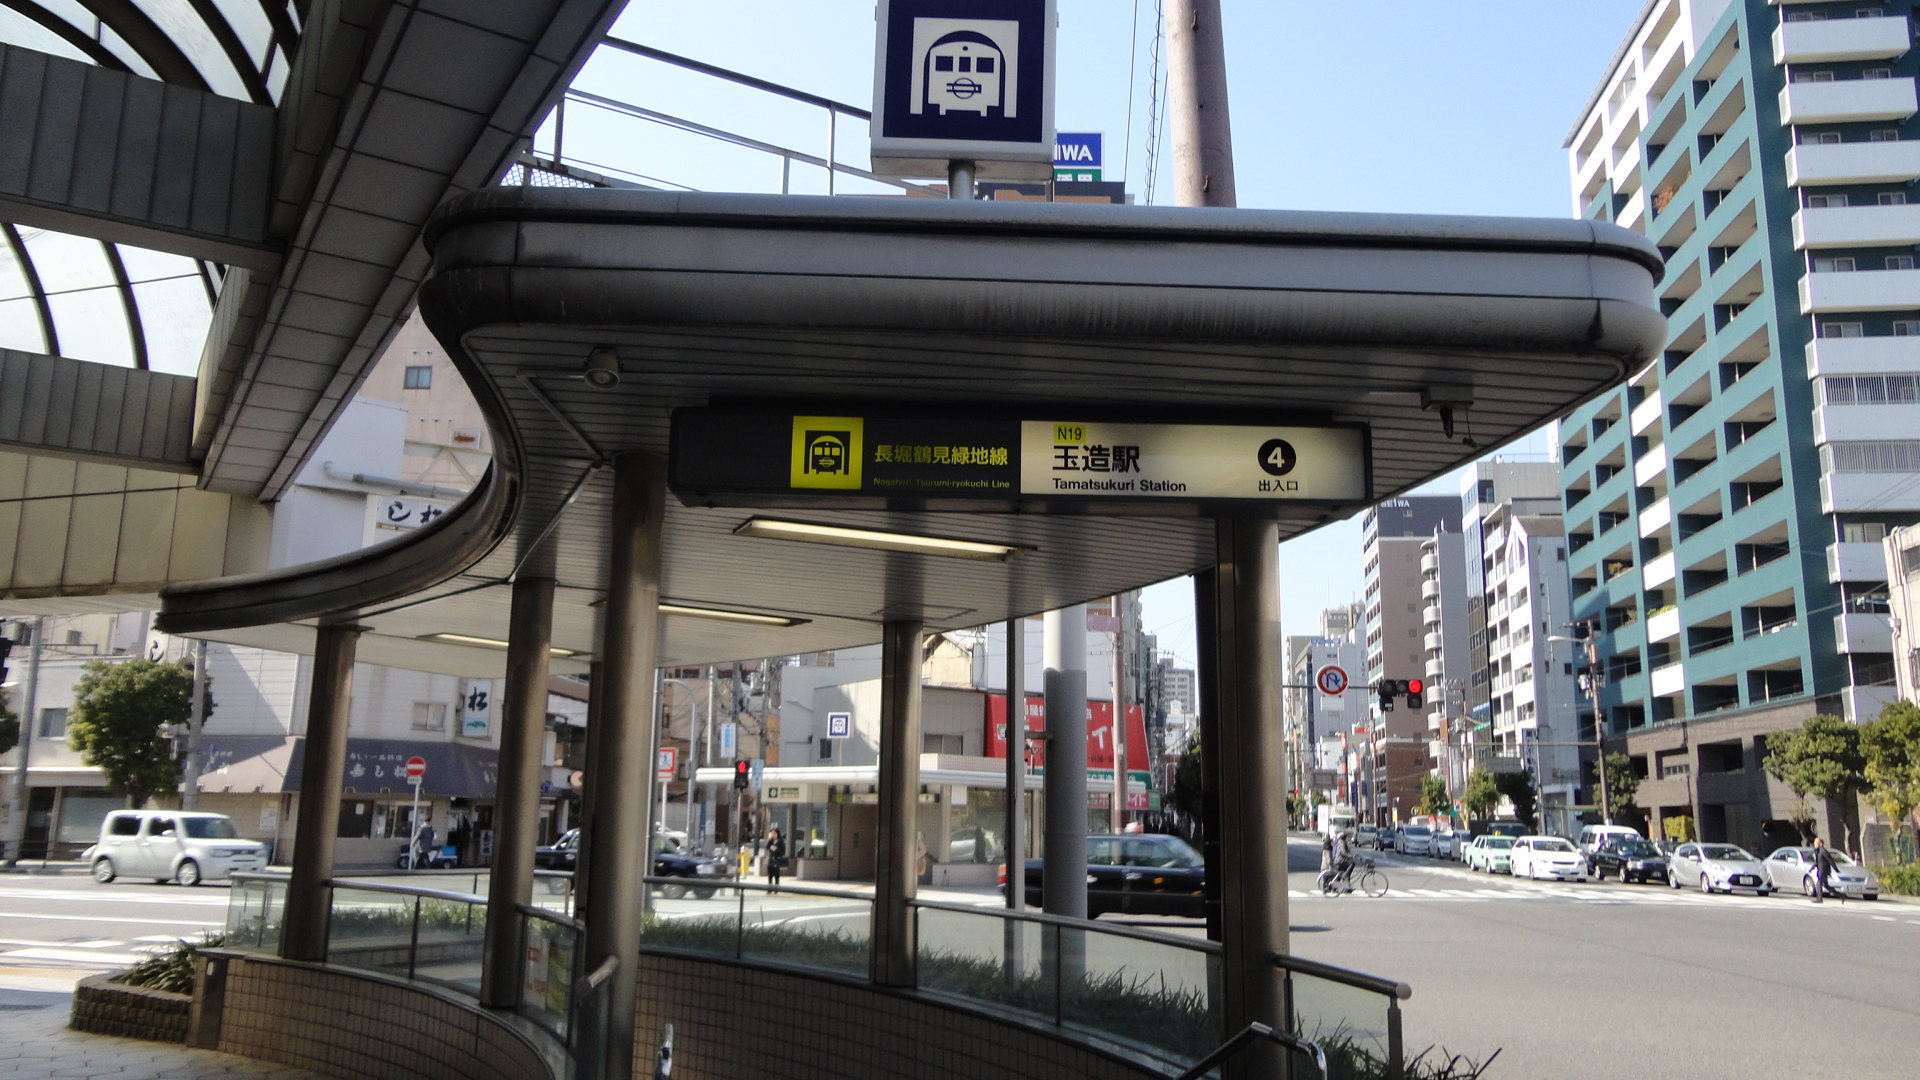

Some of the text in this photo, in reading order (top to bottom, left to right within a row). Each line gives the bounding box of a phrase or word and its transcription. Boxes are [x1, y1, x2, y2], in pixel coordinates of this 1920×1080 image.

[1057, 427, 1082, 440] N19
[874, 444, 1009, 466] 長堀鶴見緑地線
[1052, 444, 1141, 474] 玉造駅
[1267, 446, 1286, 469] 4
[873, 477, 1010, 489] Nagahori Tsurumi-ryokuchi Line
[1052, 477, 1187, 492] Tamatsukuri Station
[1258, 479, 1299, 493] 出入口
